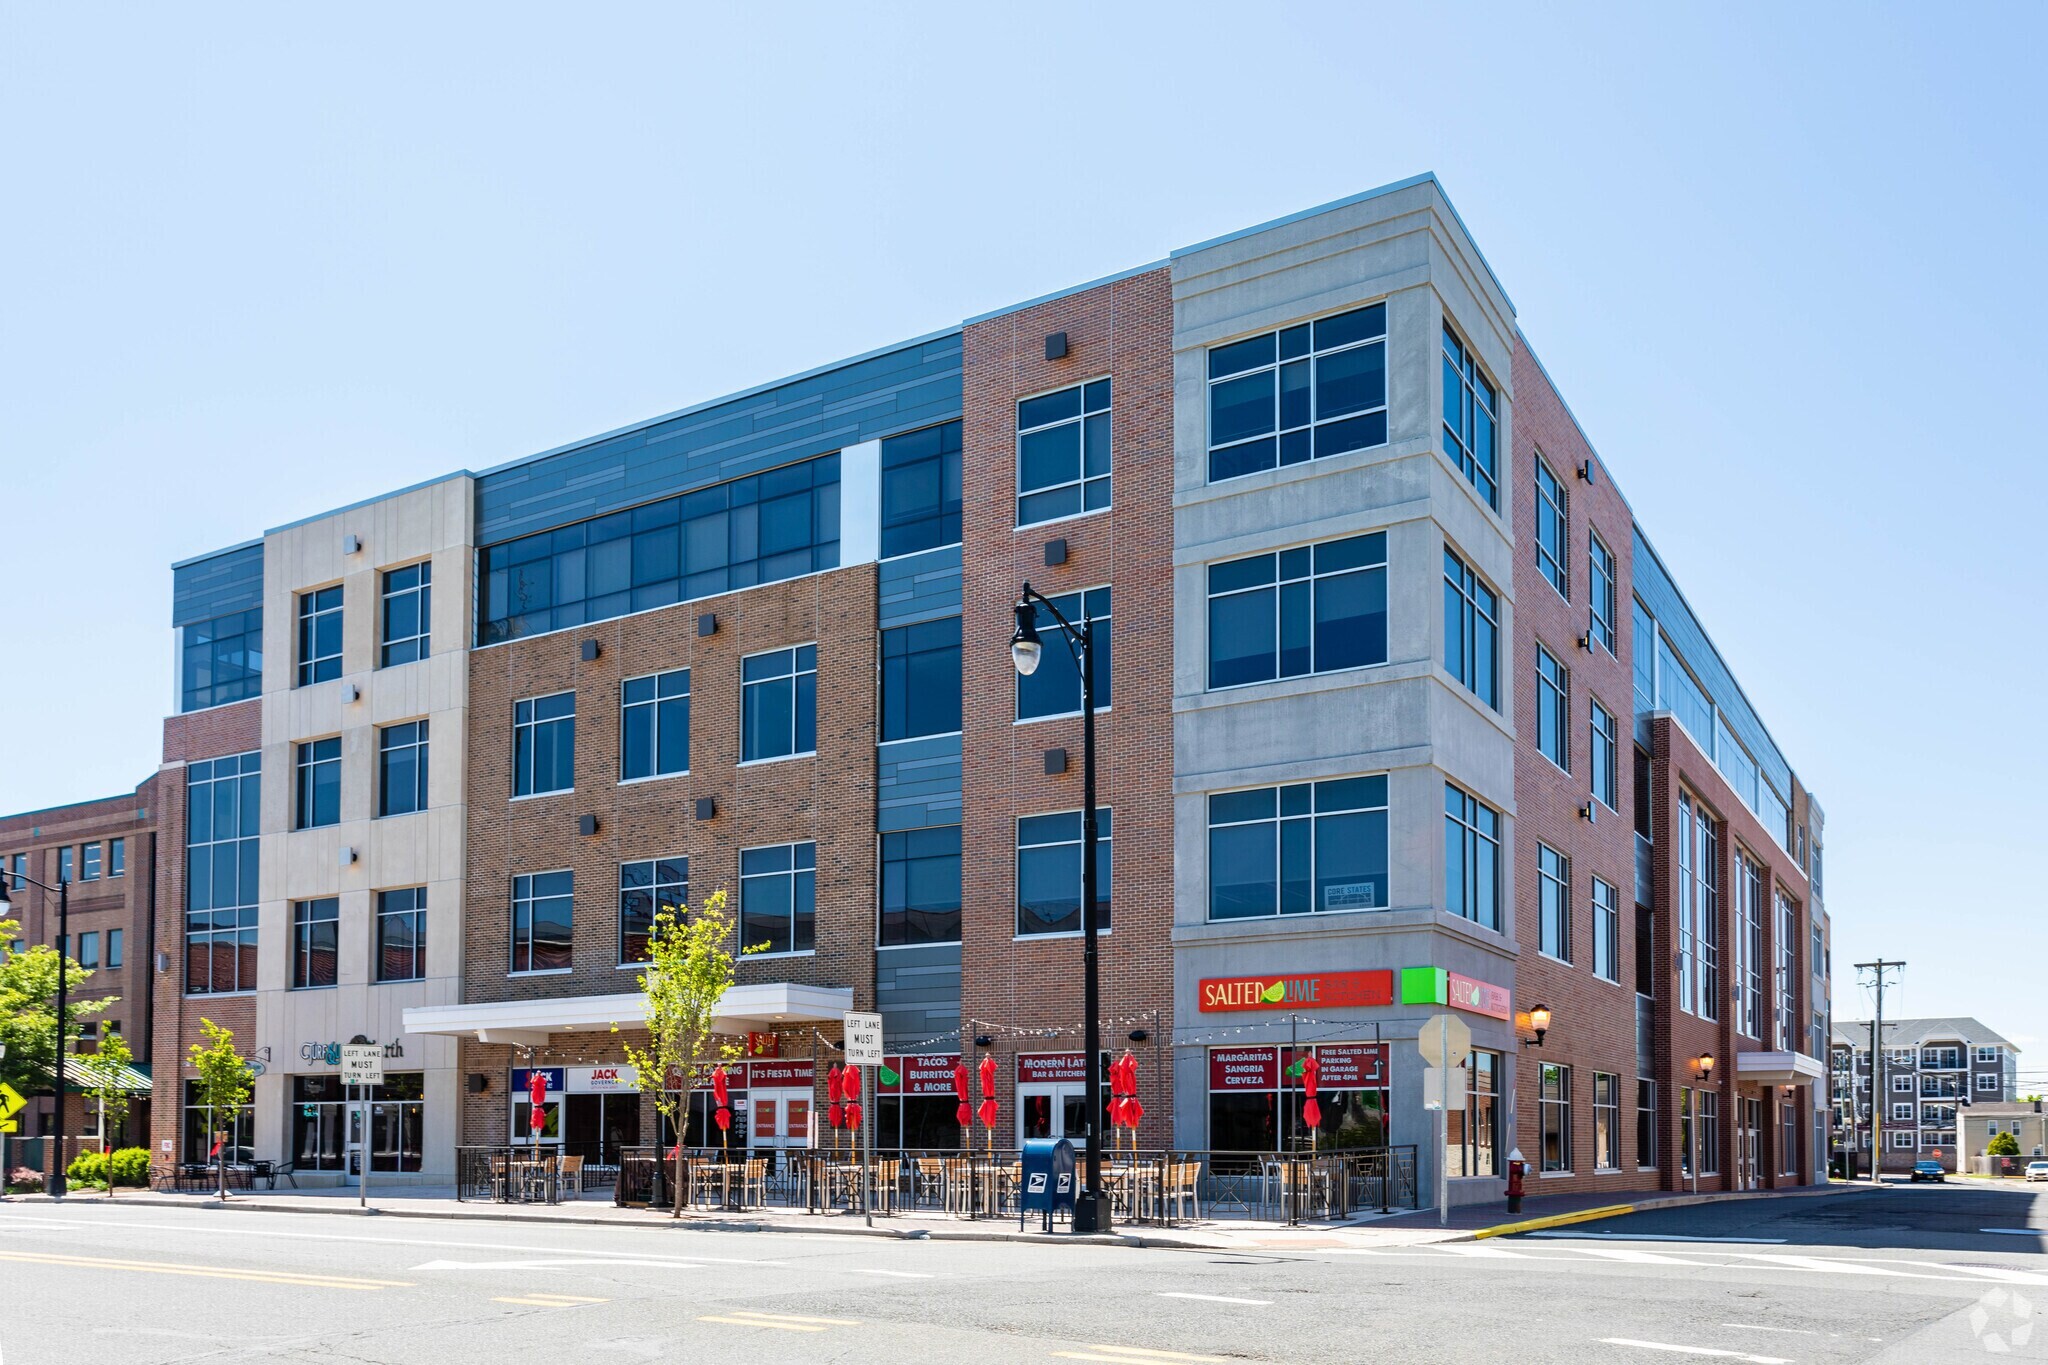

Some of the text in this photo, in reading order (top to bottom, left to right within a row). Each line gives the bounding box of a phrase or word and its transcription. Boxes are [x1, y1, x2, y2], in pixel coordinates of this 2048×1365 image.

[1347, 885, 1371, 893] STATES
[1205, 979, 1321, 1006] SALTED LIME
[847, 1019, 880, 1030] LEFT LANE
[854, 1034, 874, 1045] MUST
[848, 1048, 881, 1058] TURN LEFT
[1338, 1048, 1362, 1056] SALTED
[917, 1057, 948, 1067] TACOS
[1217, 1053, 1273, 1062] MARGARITAS
[351, 1061, 373, 1069] MUST
[1024, 1058, 1065, 1069] MODERN
[752, 1068, 813, 1079] IT'S FIESTA TIME
[1225, 1065, 1264, 1073] SANGRIA
[1329, 1065, 1358, 1073] GARAGE
[591, 1069, 618, 1080] JACK
[910, 1070, 955, 1080] BURRITOS
[1032, 1070, 1086, 1078] BAR & KITCHEN
[1321, 1074, 1341, 1082] AFTER
[1225, 1076, 1264, 1085] CERVEZA
[914, 1082, 951, 1091] & MORE
